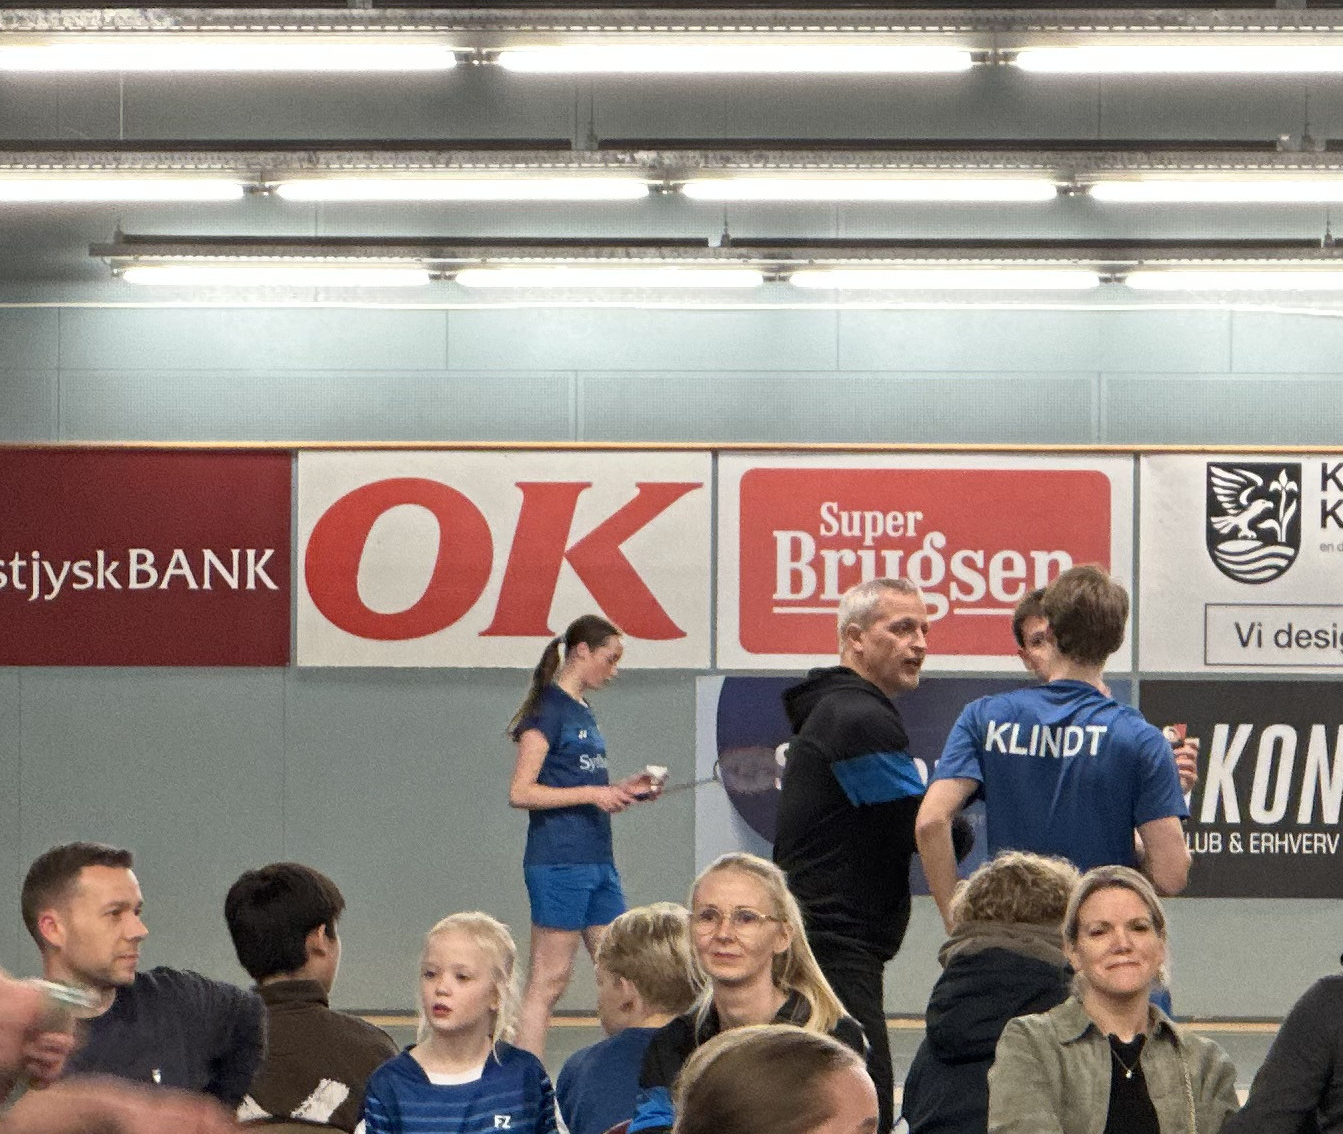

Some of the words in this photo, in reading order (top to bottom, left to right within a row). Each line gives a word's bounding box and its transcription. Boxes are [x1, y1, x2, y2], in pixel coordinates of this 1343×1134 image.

[820, 502, 924, 547] Super
[304, 477, 704, 641] OK
[1319, 543, 1334, 553] en
[772, 530, 1074, 621] Brugsen
[1235, 621, 1262, 648] Vi
[985, 720, 1108, 757] KLINDT
[1185, 832, 1223, 854] LUB
[1229, 832, 1244, 854] &
[1249, 832, 1341, 855] ERHVERV
